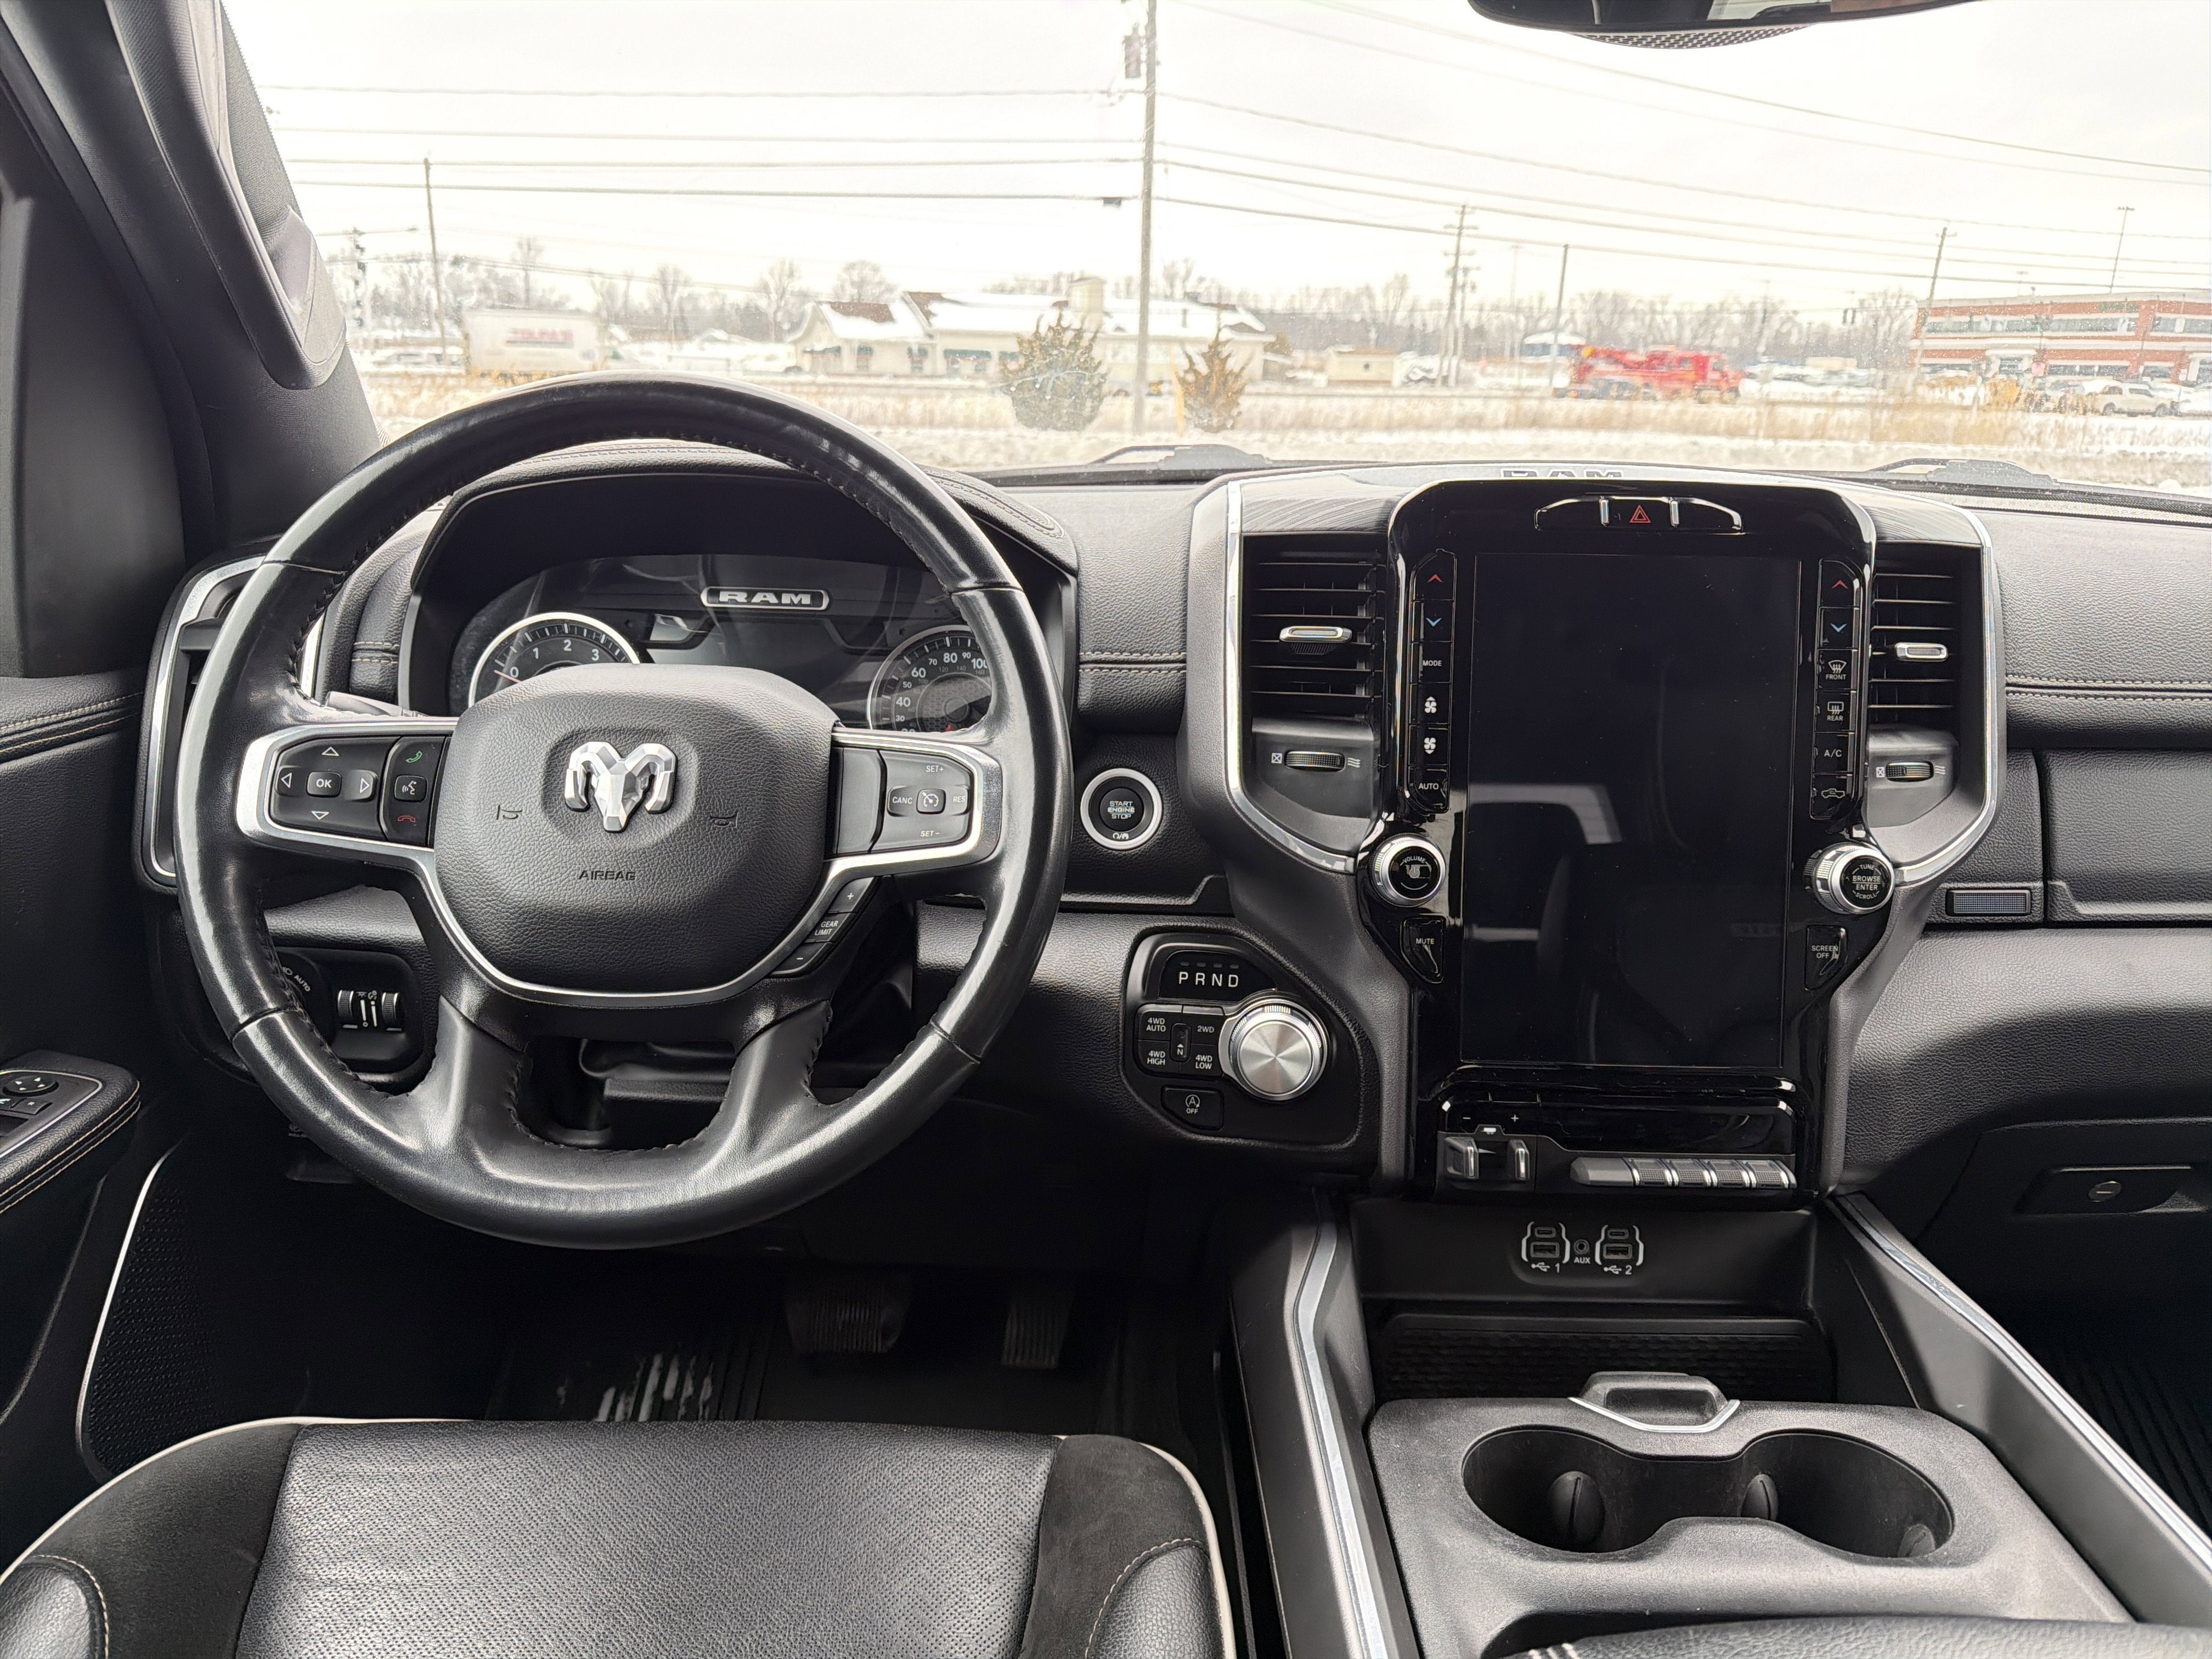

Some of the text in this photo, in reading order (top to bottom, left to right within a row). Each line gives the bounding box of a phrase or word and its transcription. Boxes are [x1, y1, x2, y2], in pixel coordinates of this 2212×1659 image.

[719, 591, 811, 605] RAM
[563, 639, 572, 651] 2
[532, 648, 539, 659] 1
[591, 649, 600, 661] 3
[943, 652, 958, 663] 80
[510, 667, 519, 678] 0
[911, 667, 926, 678] 60
[895, 697, 911, 707] 40
[1824, 749, 1842, 758] A/C
[316, 778, 332, 788] OK
[892, 796, 913, 804] CANC
[578, 870, 636, 881] AIRBAG
[294, 974, 311, 992] AUTO
[1147, 1057, 1166, 1065] HIGH
[1555, 1263, 1560, 1273] 1
[1625, 1265, 1632, 1275] 2
